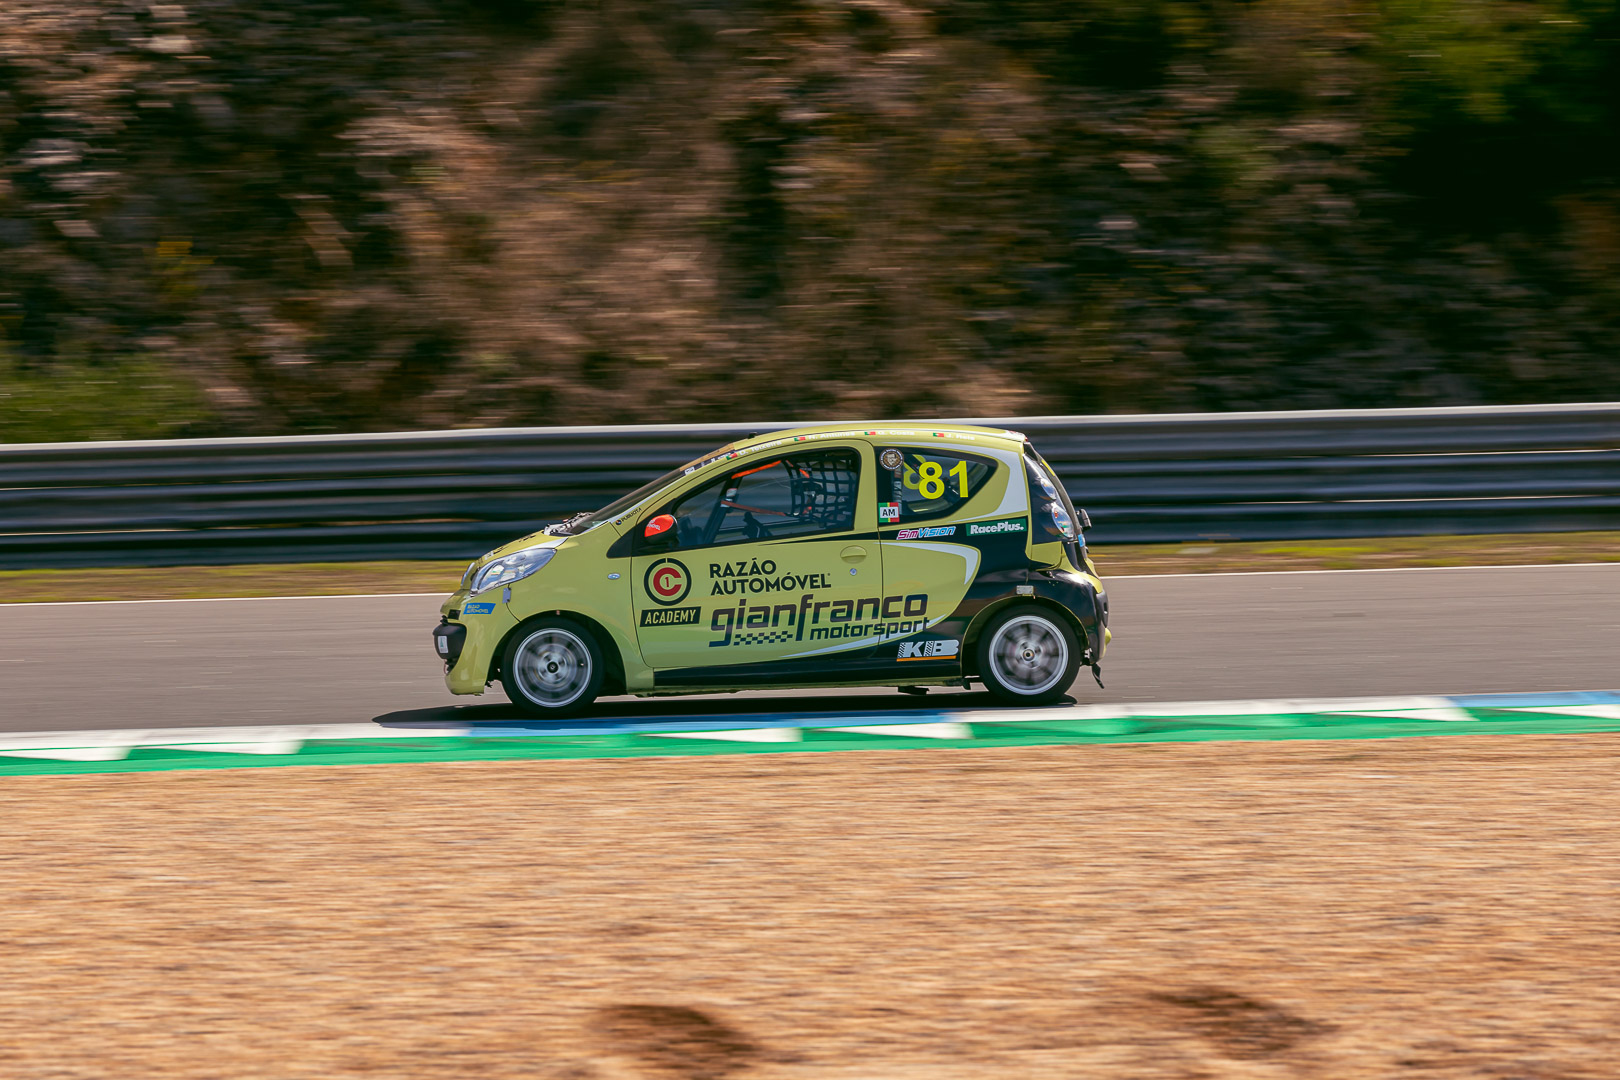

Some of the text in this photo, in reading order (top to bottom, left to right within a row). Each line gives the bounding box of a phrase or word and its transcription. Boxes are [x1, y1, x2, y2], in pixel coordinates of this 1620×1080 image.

[918, 460, 969, 500] 81
[882, 508, 896, 517] AM
[896, 526, 956, 541] SimVision
[709, 557, 777, 579] RAZÃO
[710, 572, 832, 596] AUTOMÓVEL
[645, 609, 696, 625] ACADEMY
[709, 593, 929, 647] gianfranco
[810, 617, 930, 640] motorsport
